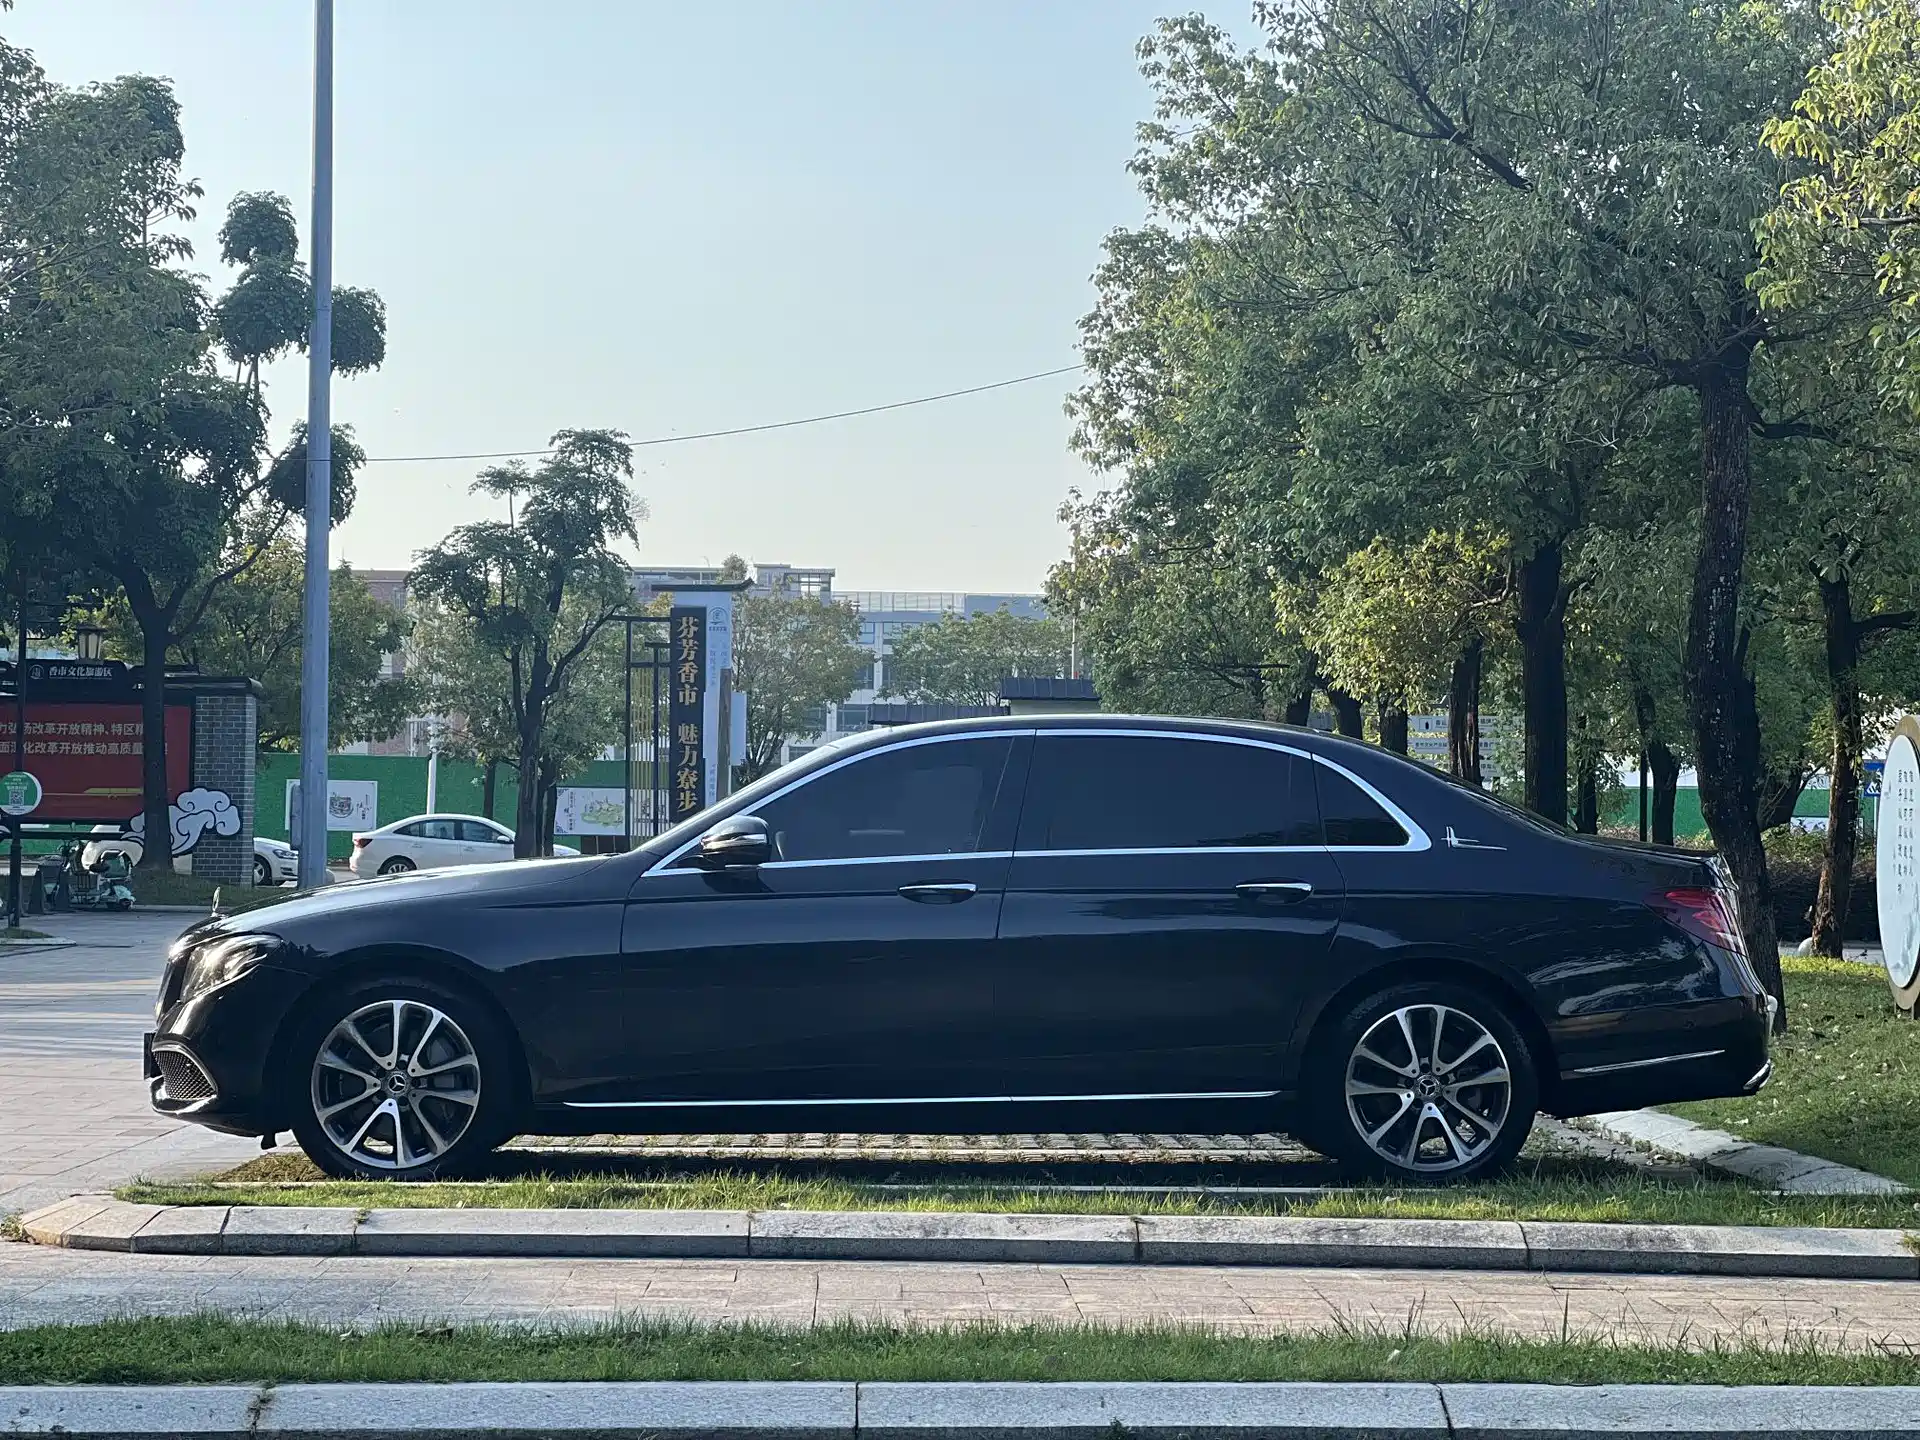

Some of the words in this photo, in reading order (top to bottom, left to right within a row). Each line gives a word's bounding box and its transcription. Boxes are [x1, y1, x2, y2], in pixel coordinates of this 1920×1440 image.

[677, 616, 699, 706] 芬芳香市
[677, 723, 699, 813] 魅力寮步
